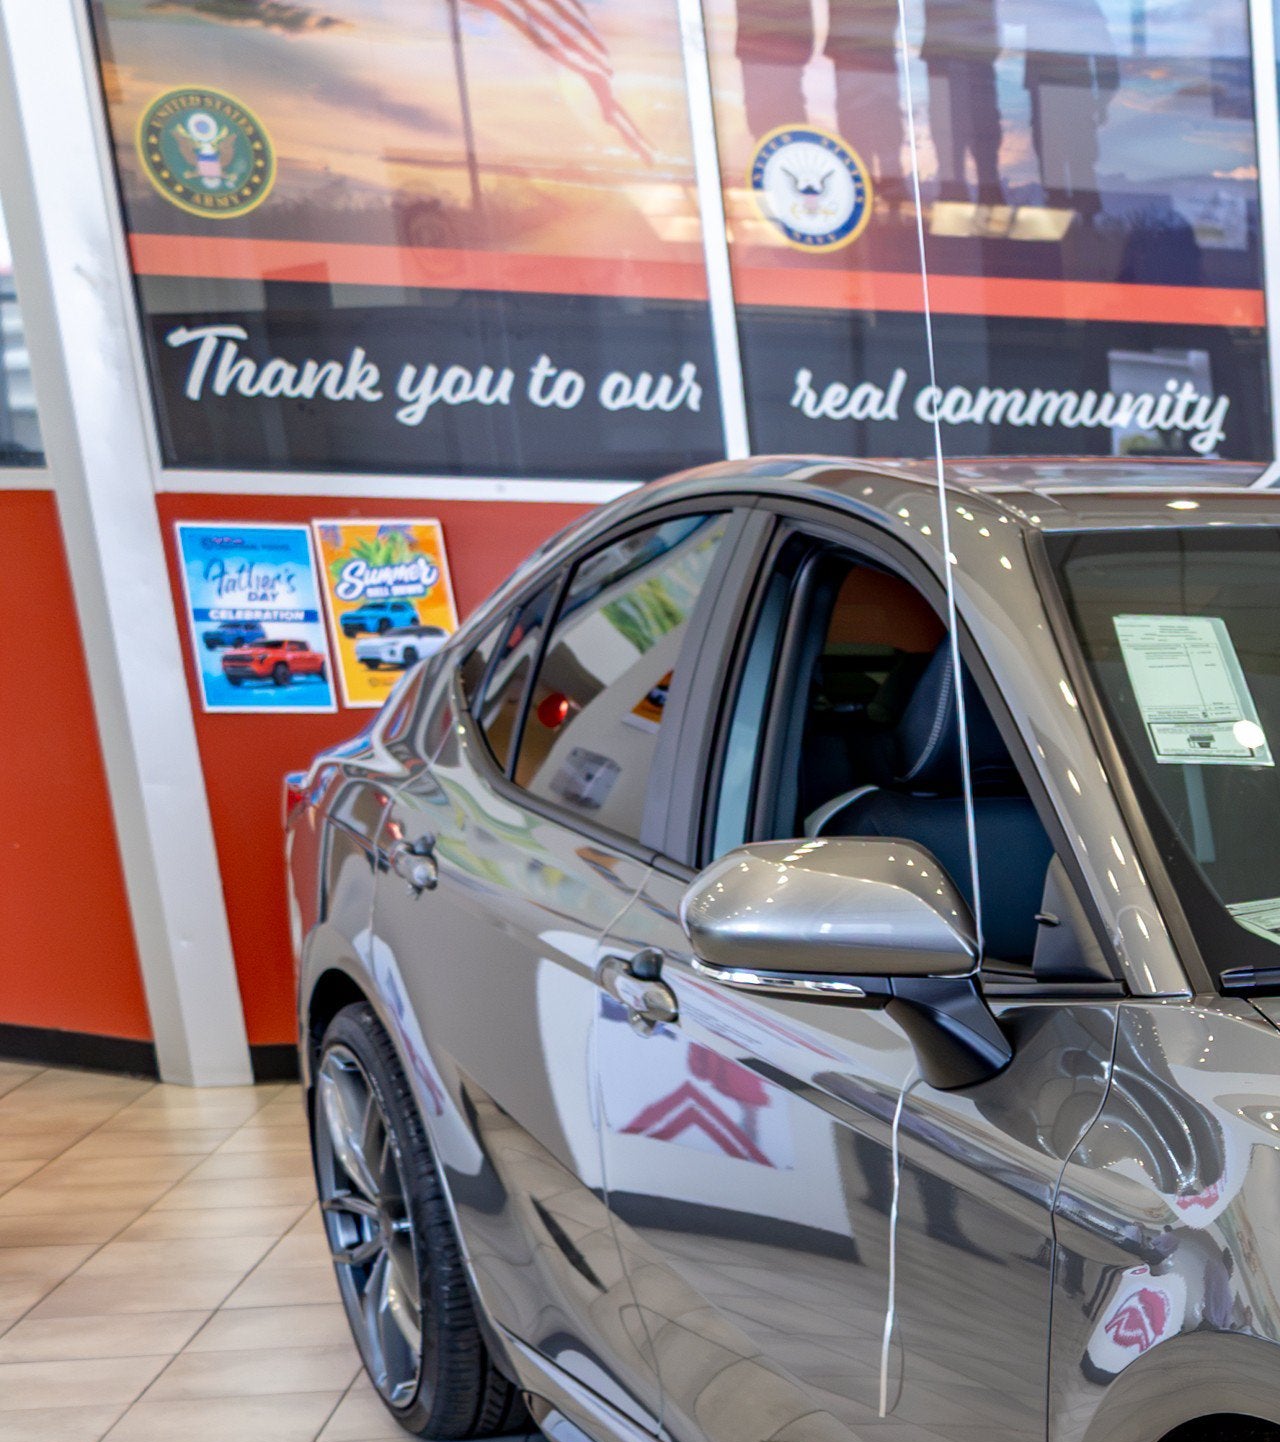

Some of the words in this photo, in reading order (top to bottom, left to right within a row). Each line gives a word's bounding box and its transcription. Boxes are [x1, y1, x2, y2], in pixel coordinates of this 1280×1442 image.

[166, 325, 384, 401] Thank
[396, 361, 515, 427] you
[527, 354, 586, 410] to
[600, 361, 702, 412] our
[791, 367, 908, 421] real
[915, 379, 1230, 454] community
[203, 558, 297, 598] Father's
[247, 591, 280, 602] DAY
[336, 557, 439, 601] Summer
[207, 609, 305, 621] CELEBRATION
